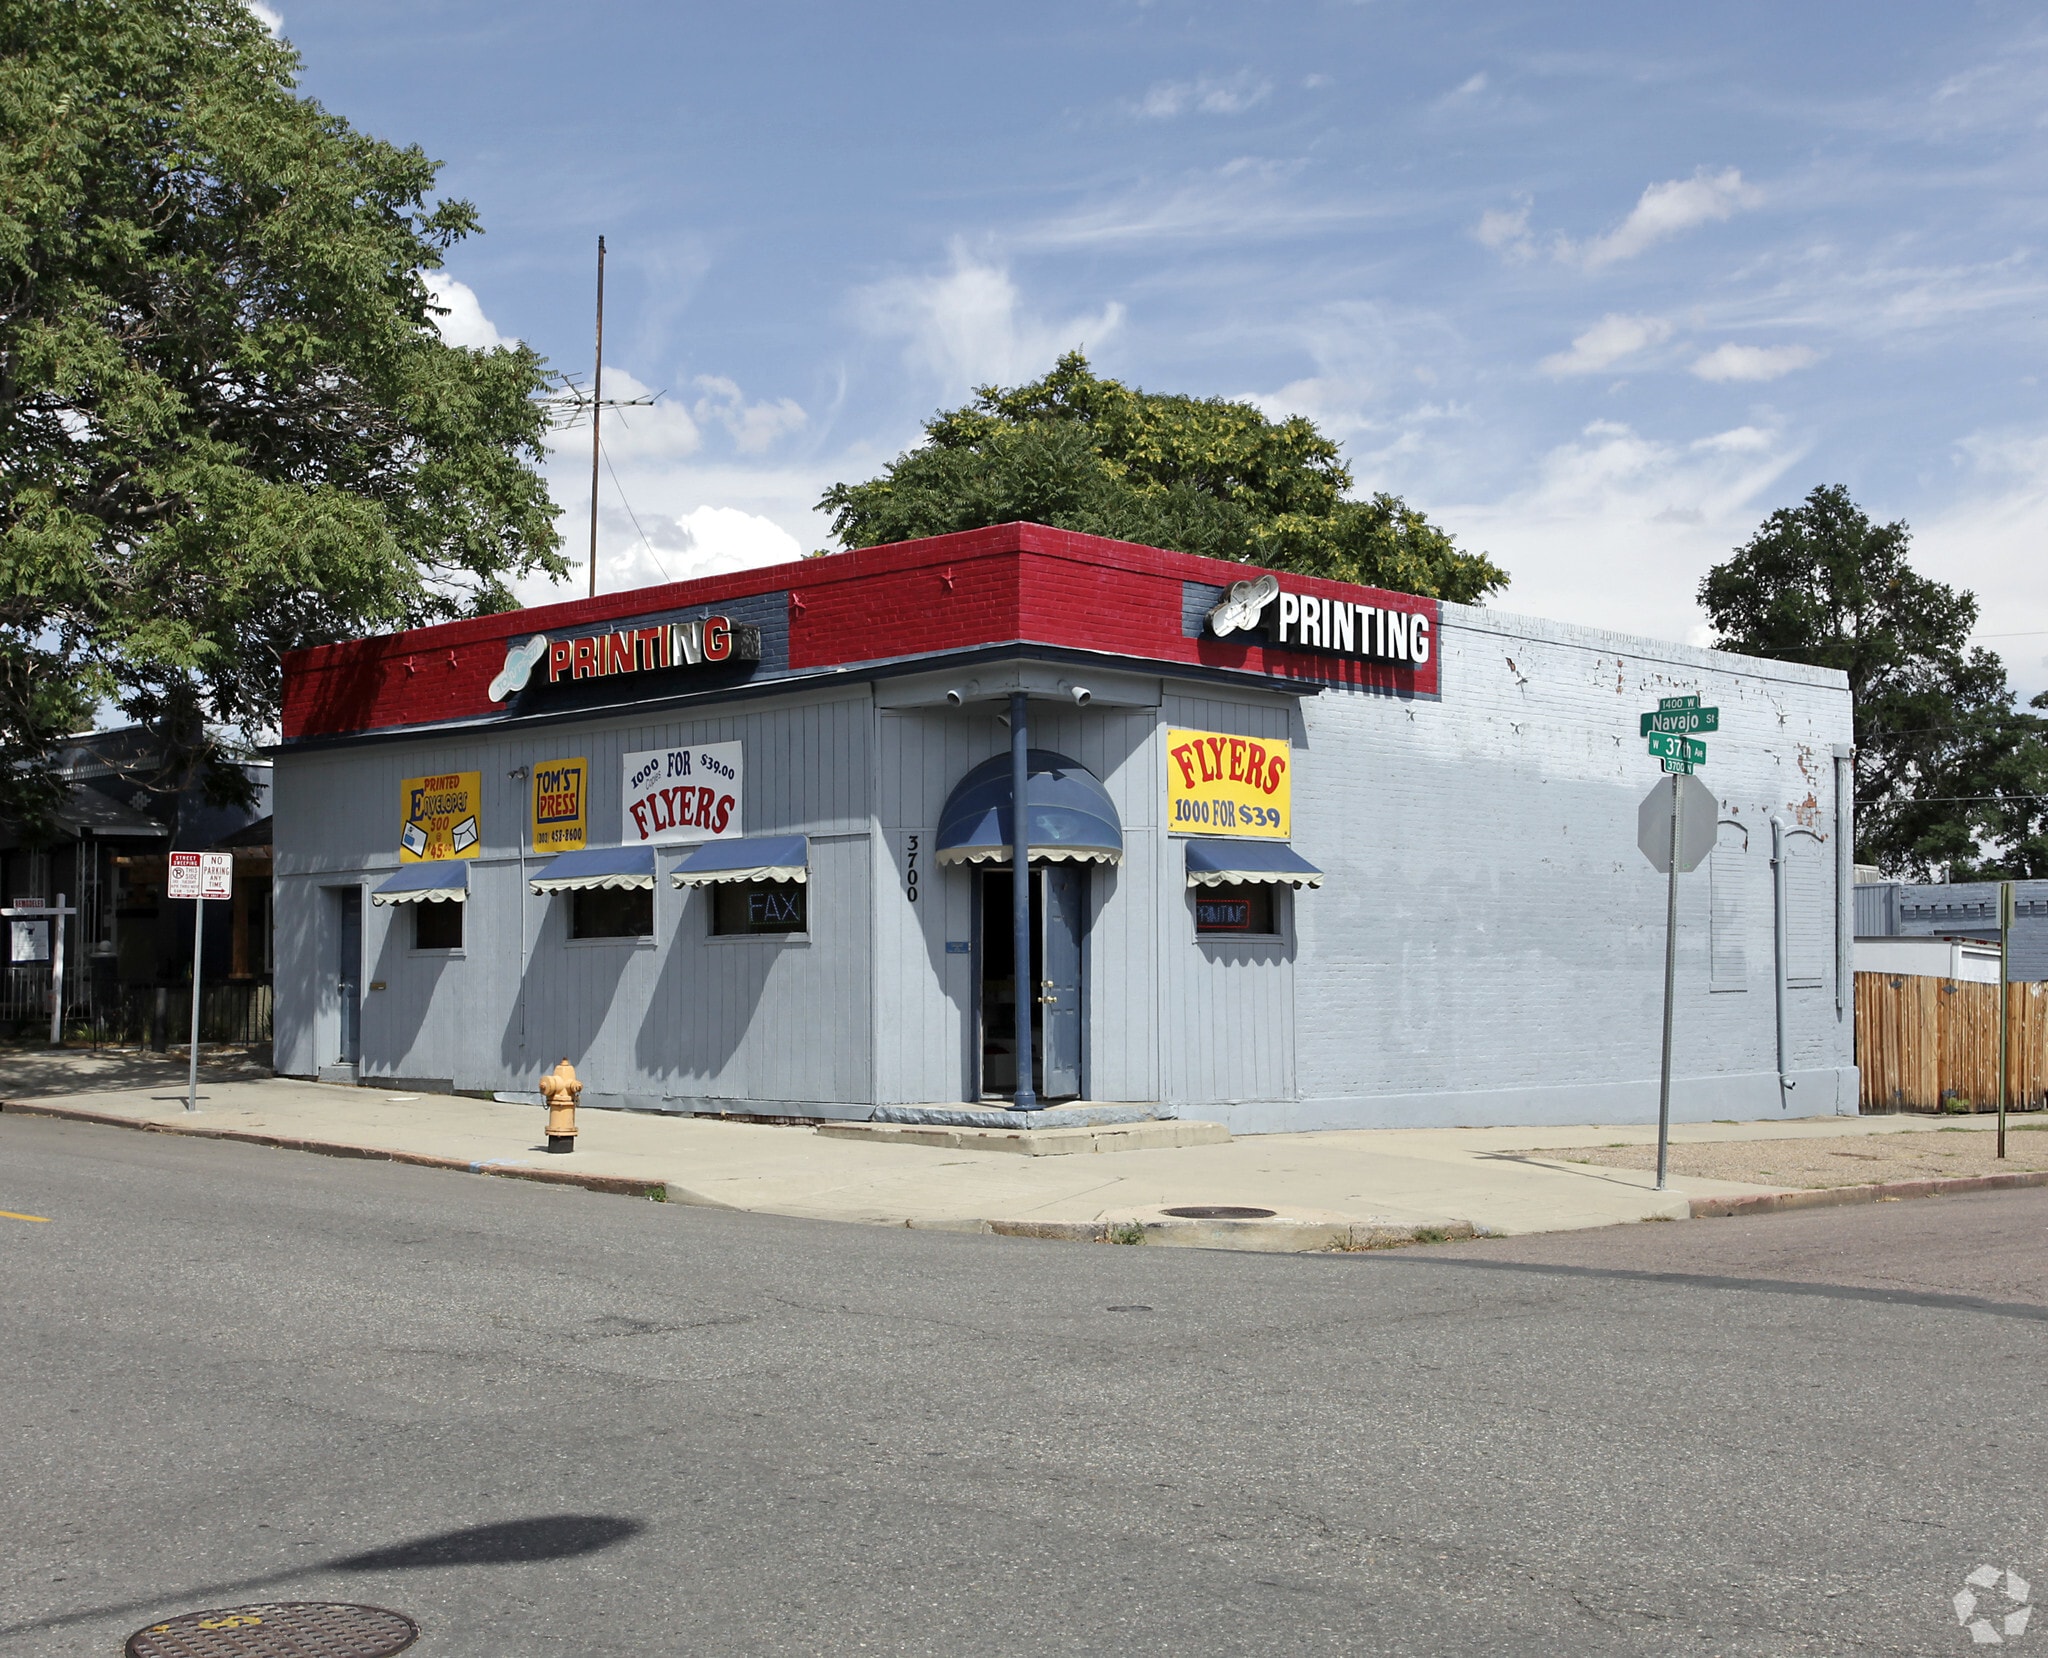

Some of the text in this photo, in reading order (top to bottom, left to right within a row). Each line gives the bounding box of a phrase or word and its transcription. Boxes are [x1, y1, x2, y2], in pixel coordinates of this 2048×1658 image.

[1279, 591, 1430, 664] PRINTING
[549, 615, 732, 683] PRINTING
[1662, 698, 1695, 709] 1400 W
[1652, 711, 1715, 733] Navajo St
[1652, 737, 1703, 759] W 37th Ave
[630, 750, 735, 790] 1000 FOR $39.00
[1171, 737, 1286, 795] FLYERS
[1667, 761, 1692, 774] 3700 N
[424, 775, 460, 792] PRINTED
[536, 767, 571, 793] TOM'S
[540, 792, 576, 818] PRESS
[629, 786, 735, 840] FLYERS
[1175, 799, 1281, 829] 1000 FOR $39
[430, 816, 450, 832] 500
[203, 867, 230, 875] PARKING
[211, 856, 223, 865] NO
[907, 835, 919, 902] 3700
[749, 892, 801, 922] FAX
